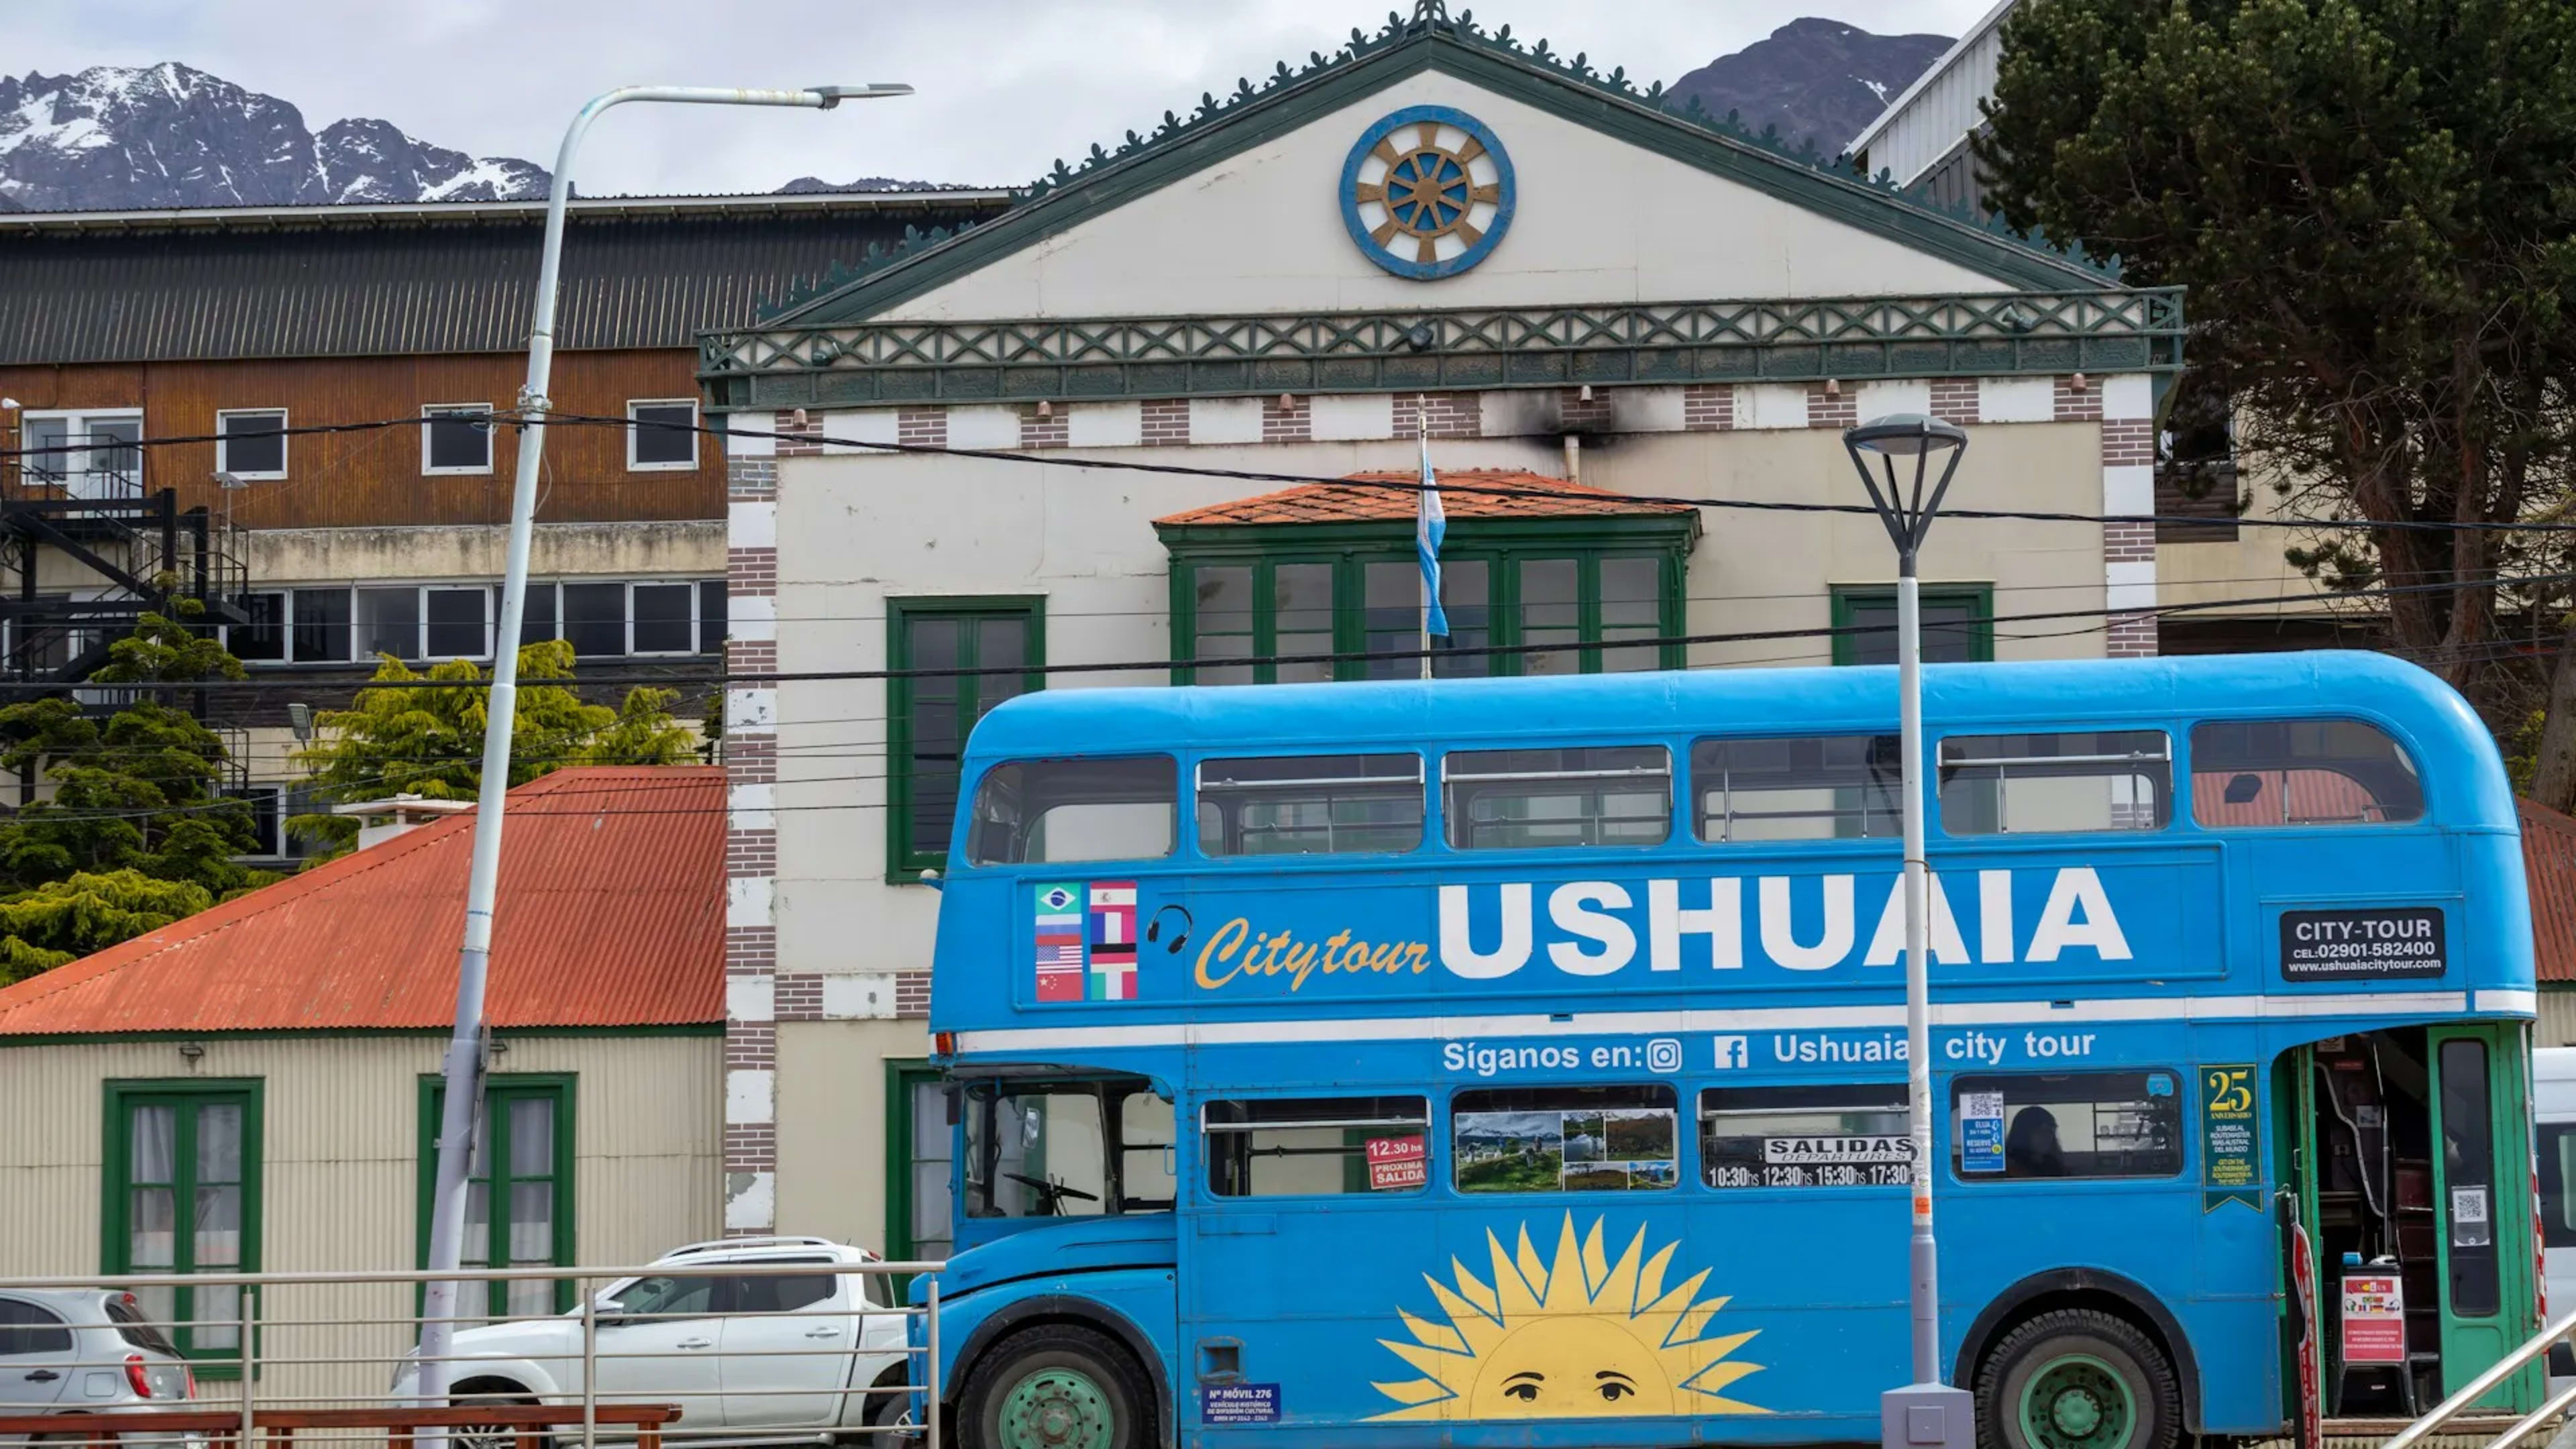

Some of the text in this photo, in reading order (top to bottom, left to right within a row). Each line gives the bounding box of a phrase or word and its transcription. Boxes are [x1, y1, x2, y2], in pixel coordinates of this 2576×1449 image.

[1439, 867, 2133, 978] USHUAIA
[2296, 919, 2432, 941] CITY-TOUR
[2288, 958, 2441, 972] www.ushuaiacitytour.com
[1774, 1031, 2096, 1065] Ushuaia city tour
[1443, 1042, 1642, 1076] Síganos en:
[2209, 1069, 2251, 1112] 25
[1370, 1141, 1408, 1156] 12.30
[1771, 1138, 1911, 1153] SALIDAS
[1782, 1152, 1906, 1162] DEPARTURES
[1377, 1170, 1426, 1183] SALIDA
[1224, 1387, 1254, 1399] MÓVIL
[1255, 1389, 1272, 1399] 276
